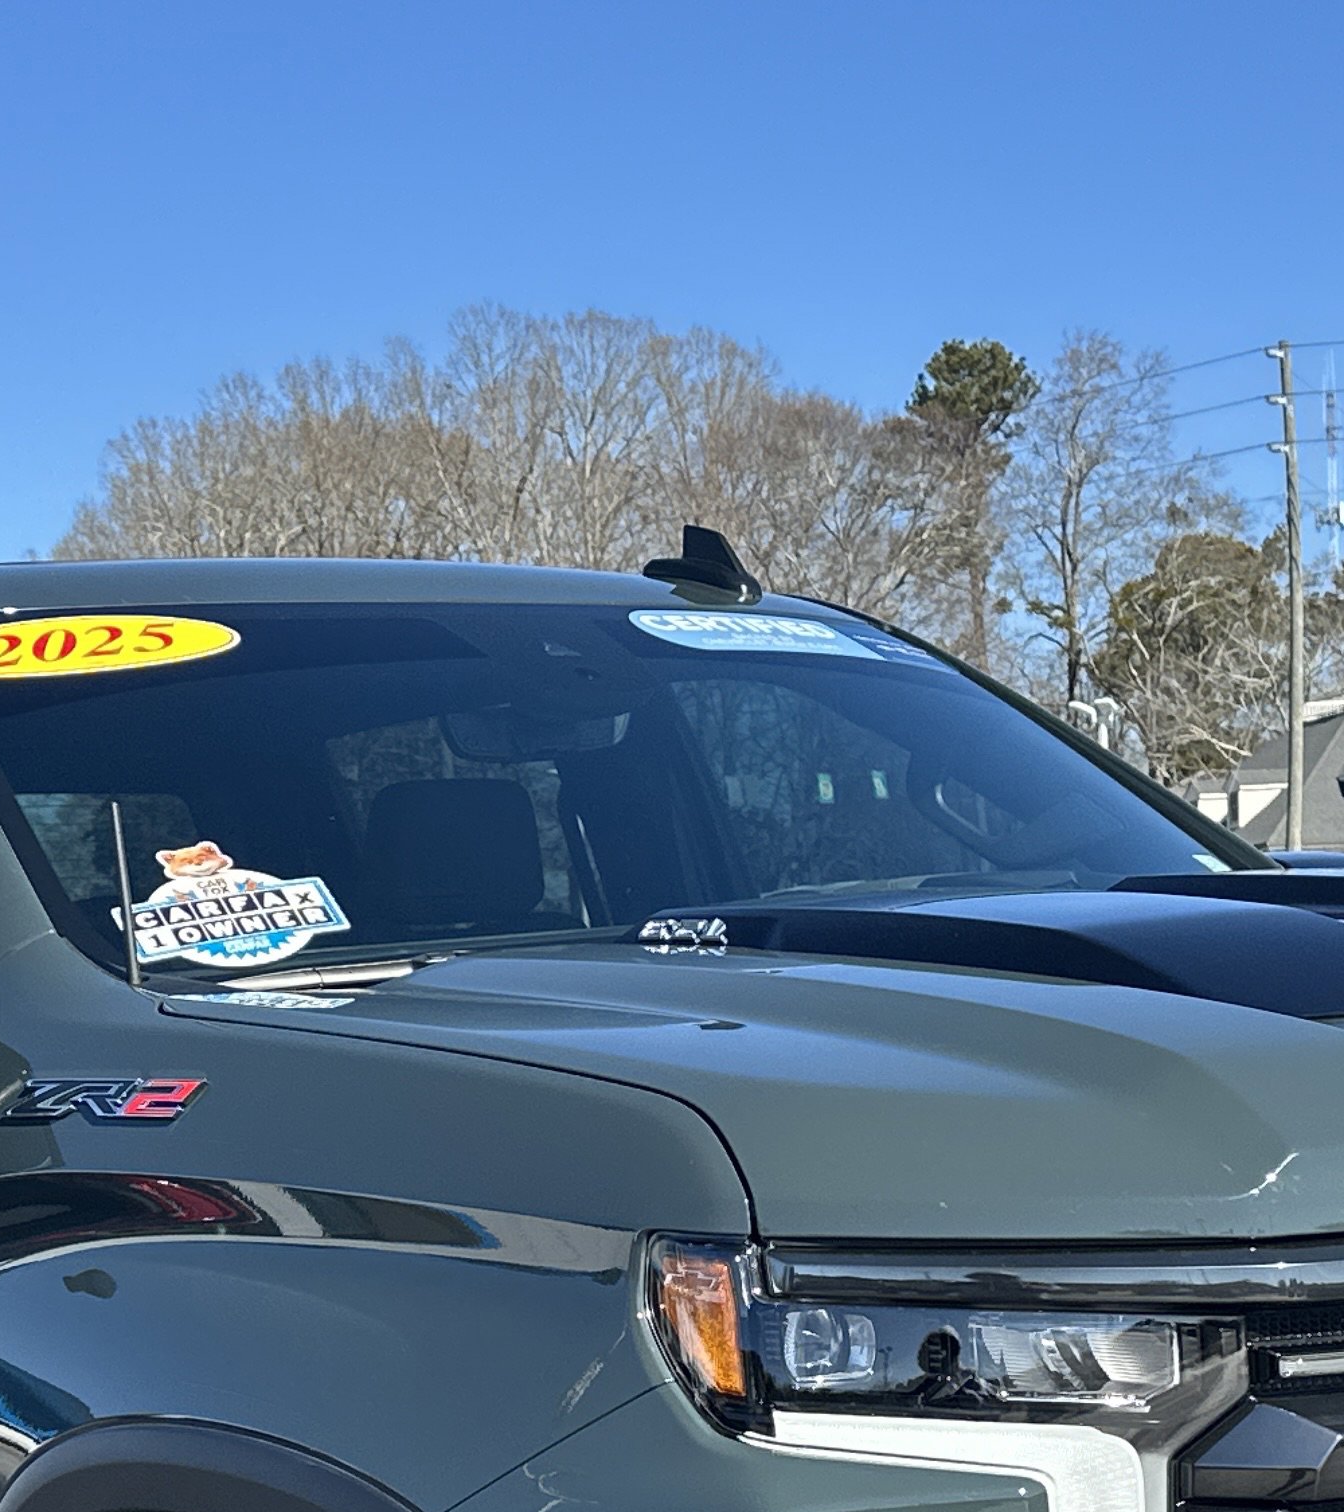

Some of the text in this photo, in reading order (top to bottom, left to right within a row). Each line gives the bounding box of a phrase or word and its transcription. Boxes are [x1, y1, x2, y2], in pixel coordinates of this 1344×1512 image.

[638, 613, 837, 640] CERTIFIED
[134, 889, 315, 929] CARFAX
[177, 907, 329, 944] OWNER
[1, 1077, 209, 1121] ZR2
